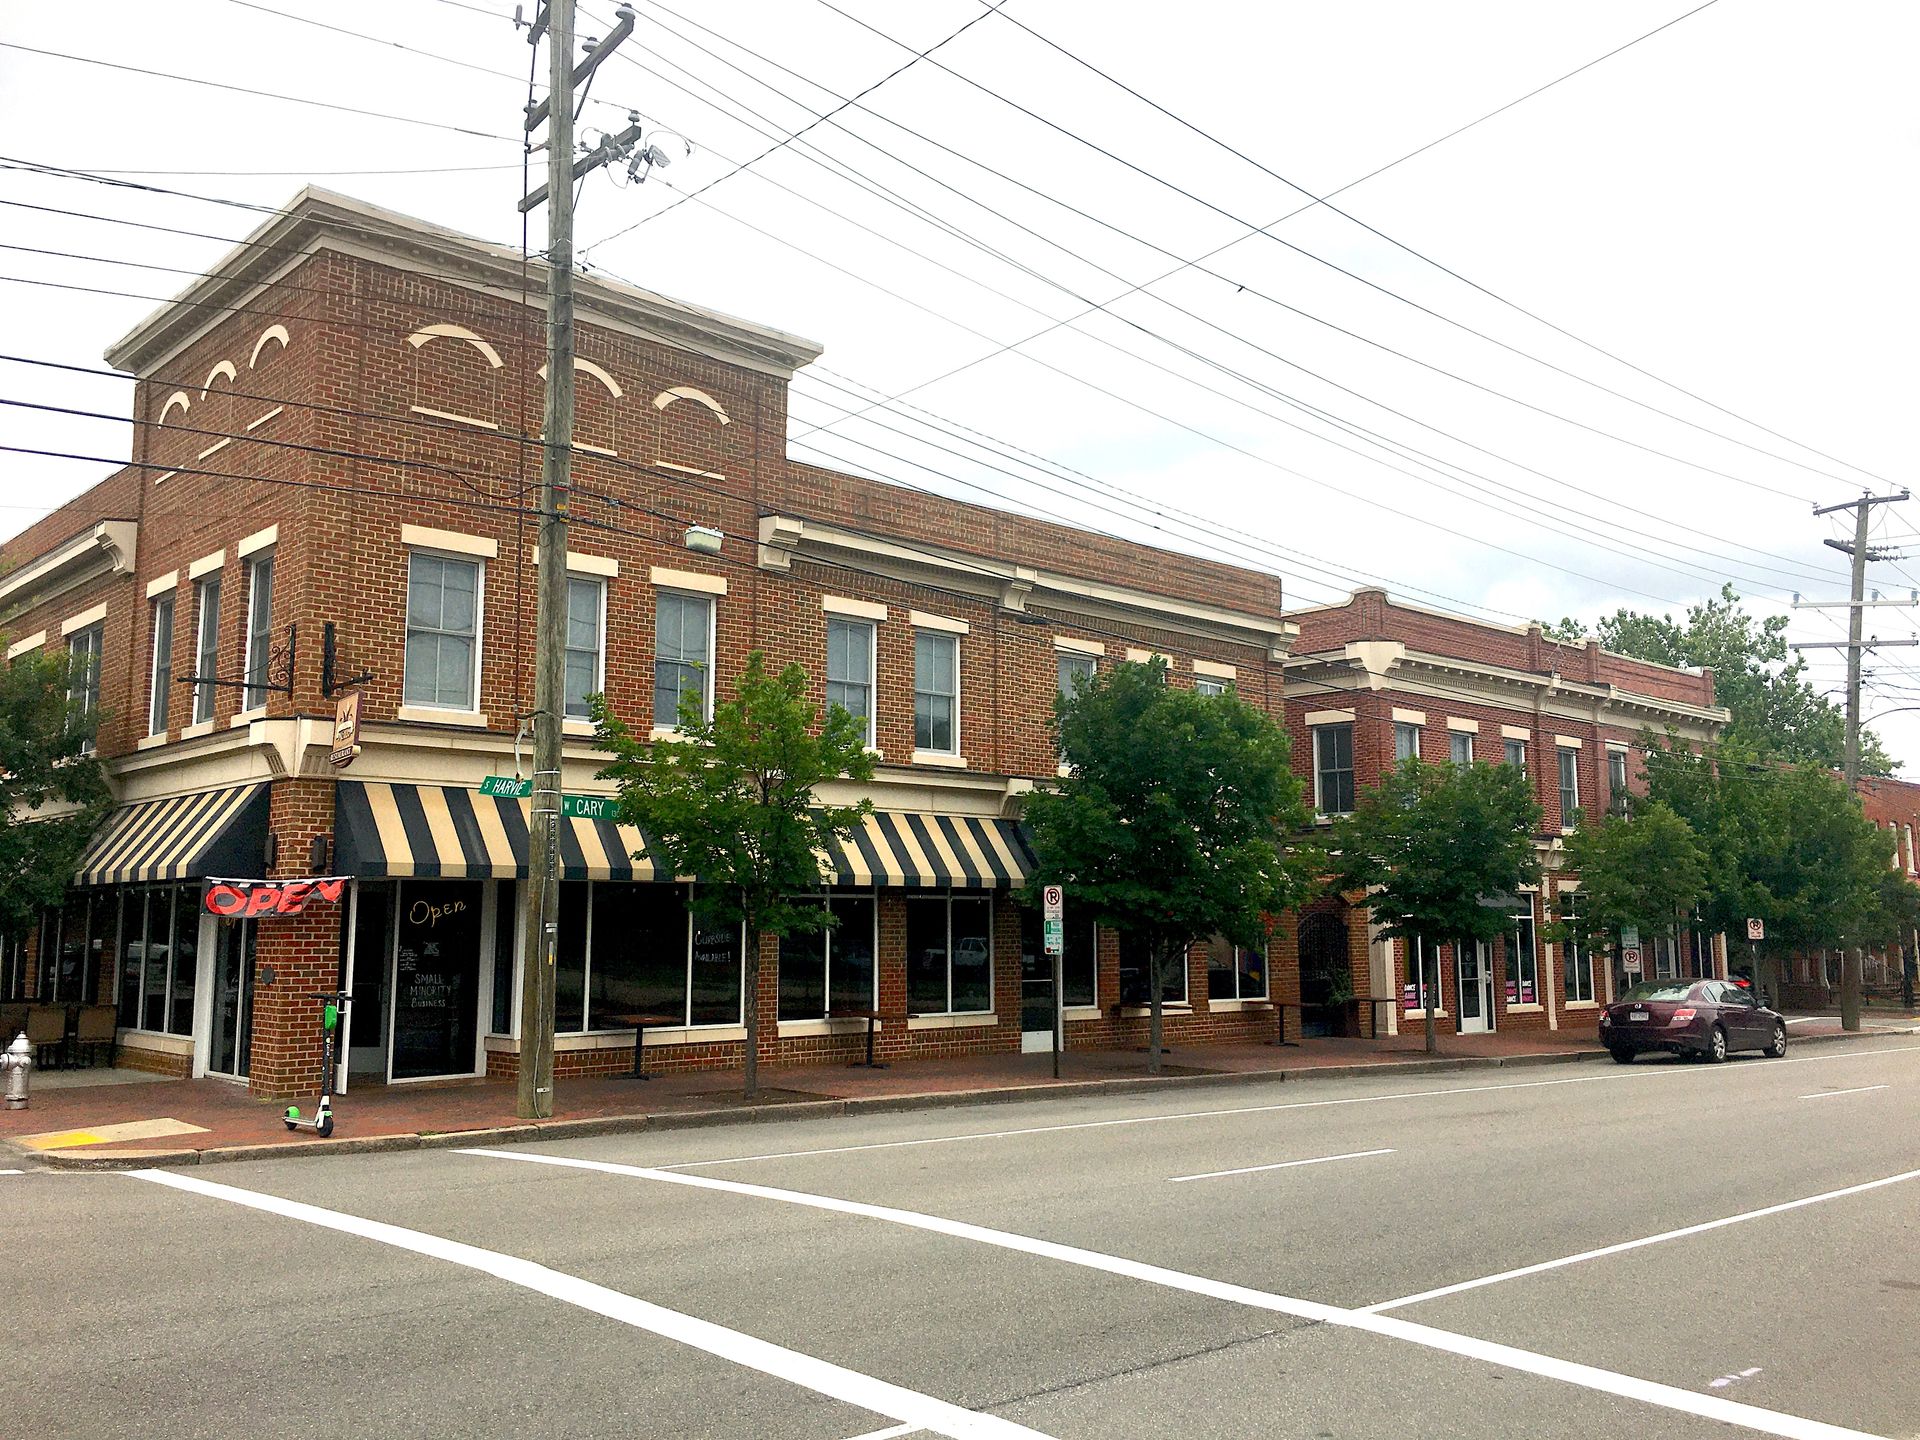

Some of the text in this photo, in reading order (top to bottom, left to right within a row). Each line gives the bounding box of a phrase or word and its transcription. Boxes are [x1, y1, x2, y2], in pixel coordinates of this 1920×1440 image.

[484, 780, 490, 789] S
[492, 779, 526, 796] HARVIE
[564, 801, 571, 811] W
[576, 799, 605, 816] CARY
[205, 879, 345, 916] OPEN
[409, 900, 467, 929] Open
[414, 973, 443, 985] SMALL
[410, 985, 451, 997] MINORITY
[411, 997, 446, 1008] BUSINESS
